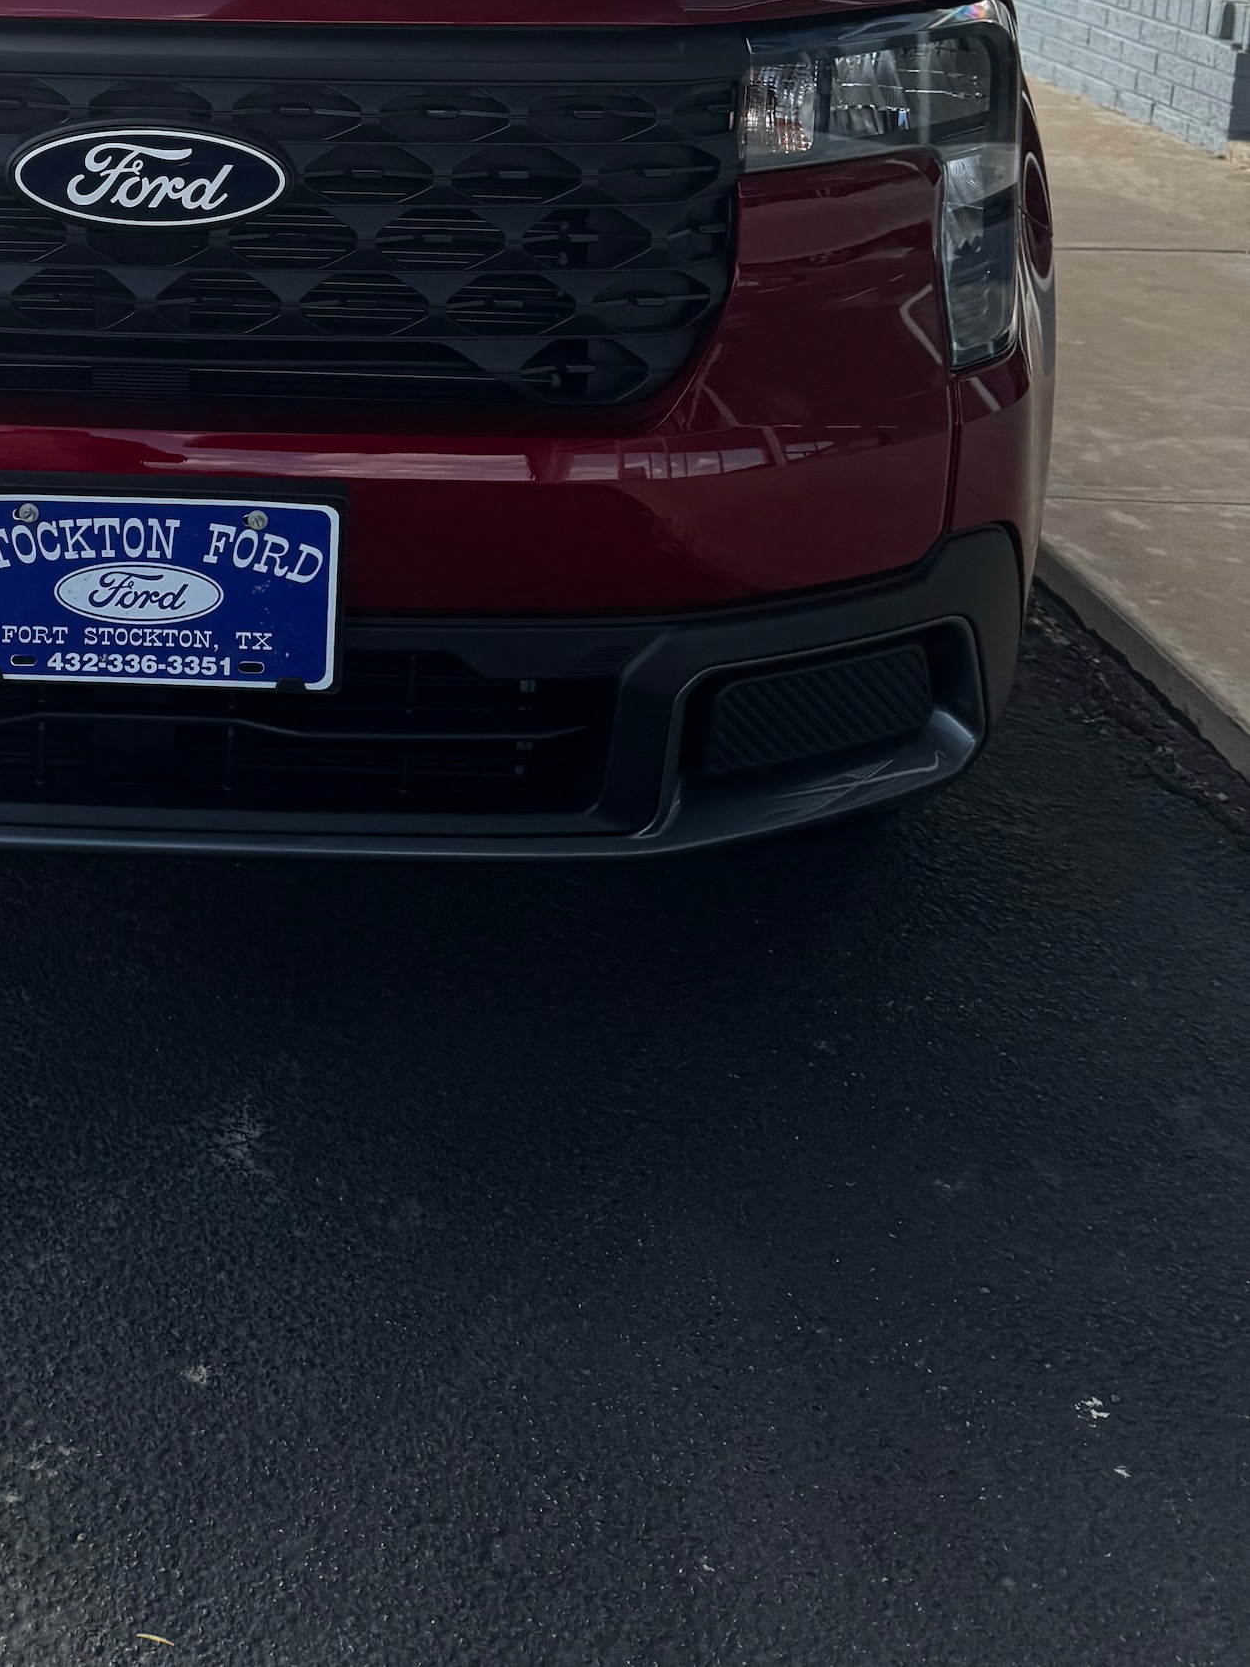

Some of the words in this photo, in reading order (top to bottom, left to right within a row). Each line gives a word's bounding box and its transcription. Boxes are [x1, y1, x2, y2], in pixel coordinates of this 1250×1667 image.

[66, 142, 235, 211] Ford
[202, 522, 324, 584] FORD
[88, 570, 189, 611] Ford
[1, 625, 69, 645] FORT
[83, 626, 219, 652] STOCKTON,
[236, 631, 273, 652] TX
[46, 651, 232, 676] 432-336-3351
